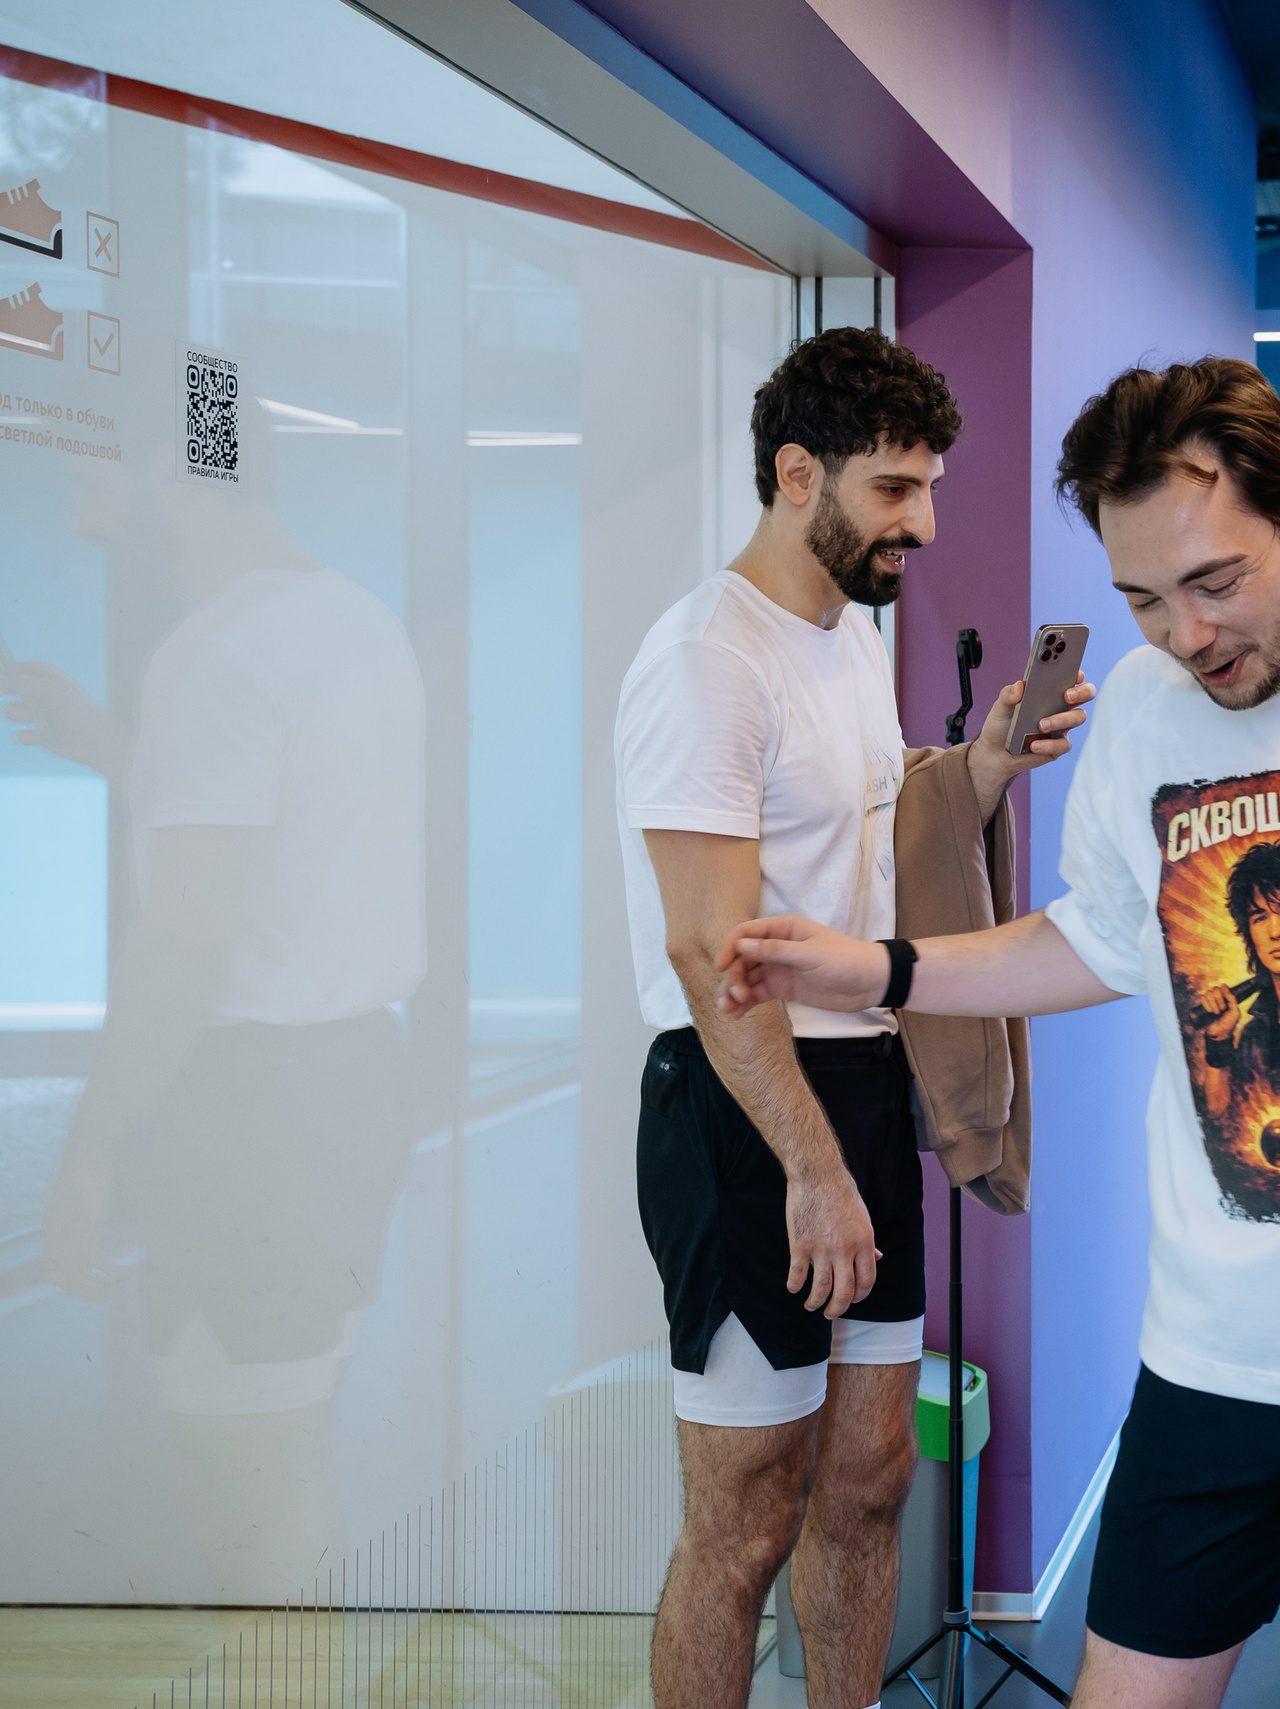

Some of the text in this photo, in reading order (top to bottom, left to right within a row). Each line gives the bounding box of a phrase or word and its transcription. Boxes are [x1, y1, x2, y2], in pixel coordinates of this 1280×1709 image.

[187, 351, 238, 373] СООБЩЕСТВО
[16, 396, 62, 419] только
[66, 408, 73, 421] в
[77, 408, 115, 432] обуви
[57, 437, 122, 461] подошвой
[188, 465, 239, 483] ПРАВИЛА ИГРЫ
